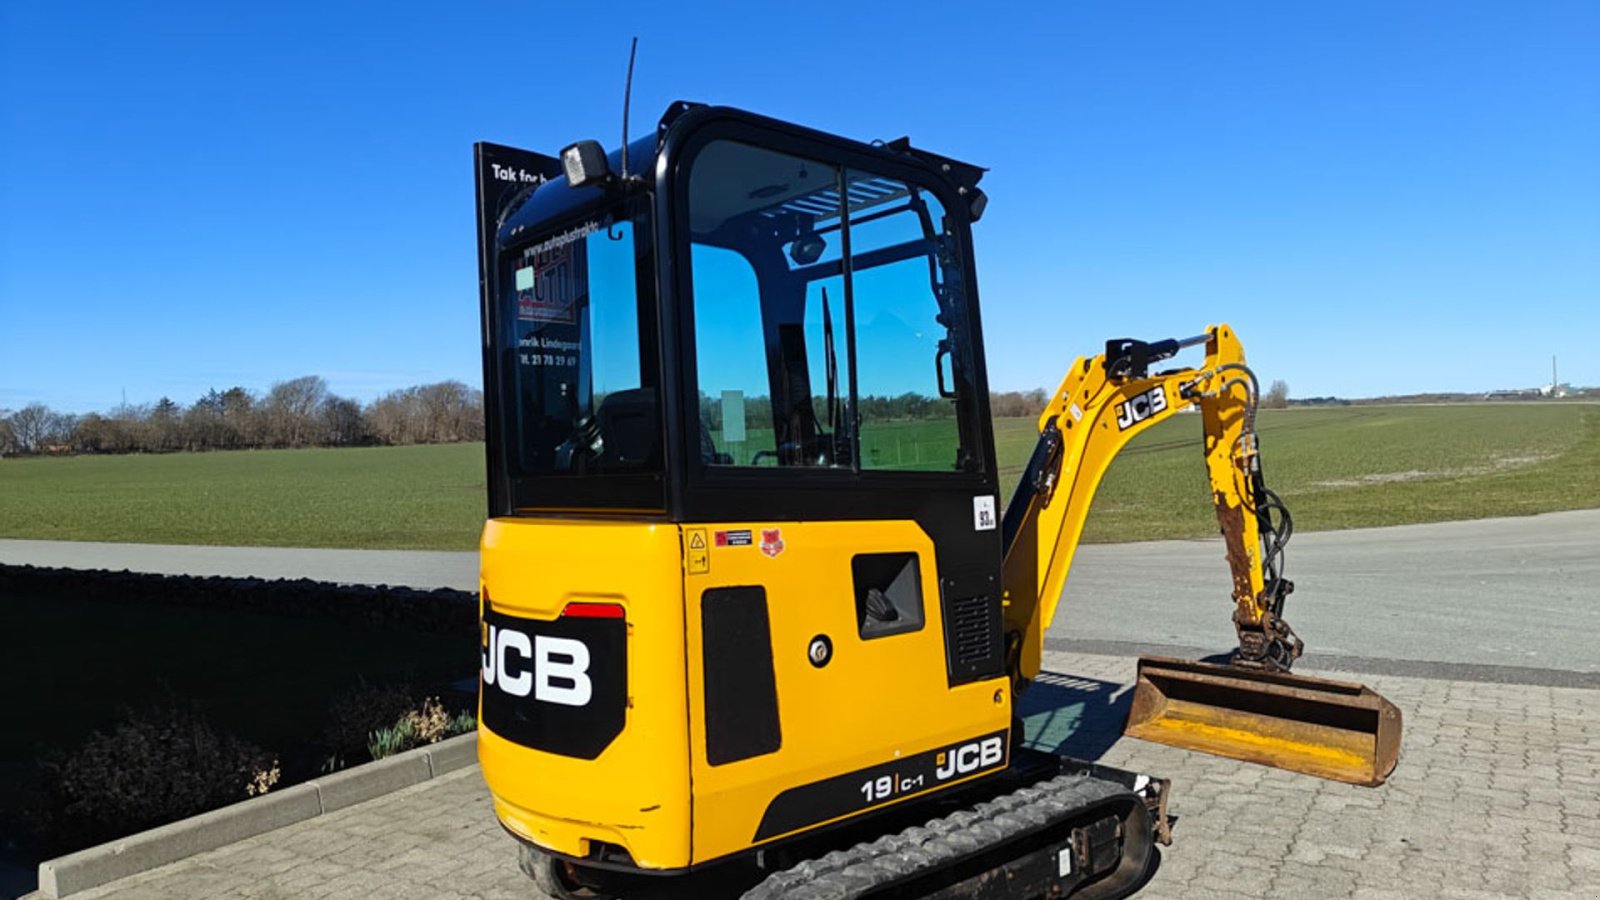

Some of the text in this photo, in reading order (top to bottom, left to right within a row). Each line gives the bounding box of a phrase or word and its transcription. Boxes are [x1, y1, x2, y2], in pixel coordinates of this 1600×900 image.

[491, 164, 517, 182] Tak
[1118, 387, 1167, 429] JCB
[482, 624, 593, 707] JCB
[860, 775, 893, 802] 19
[936, 736, 1003, 780] JCB
